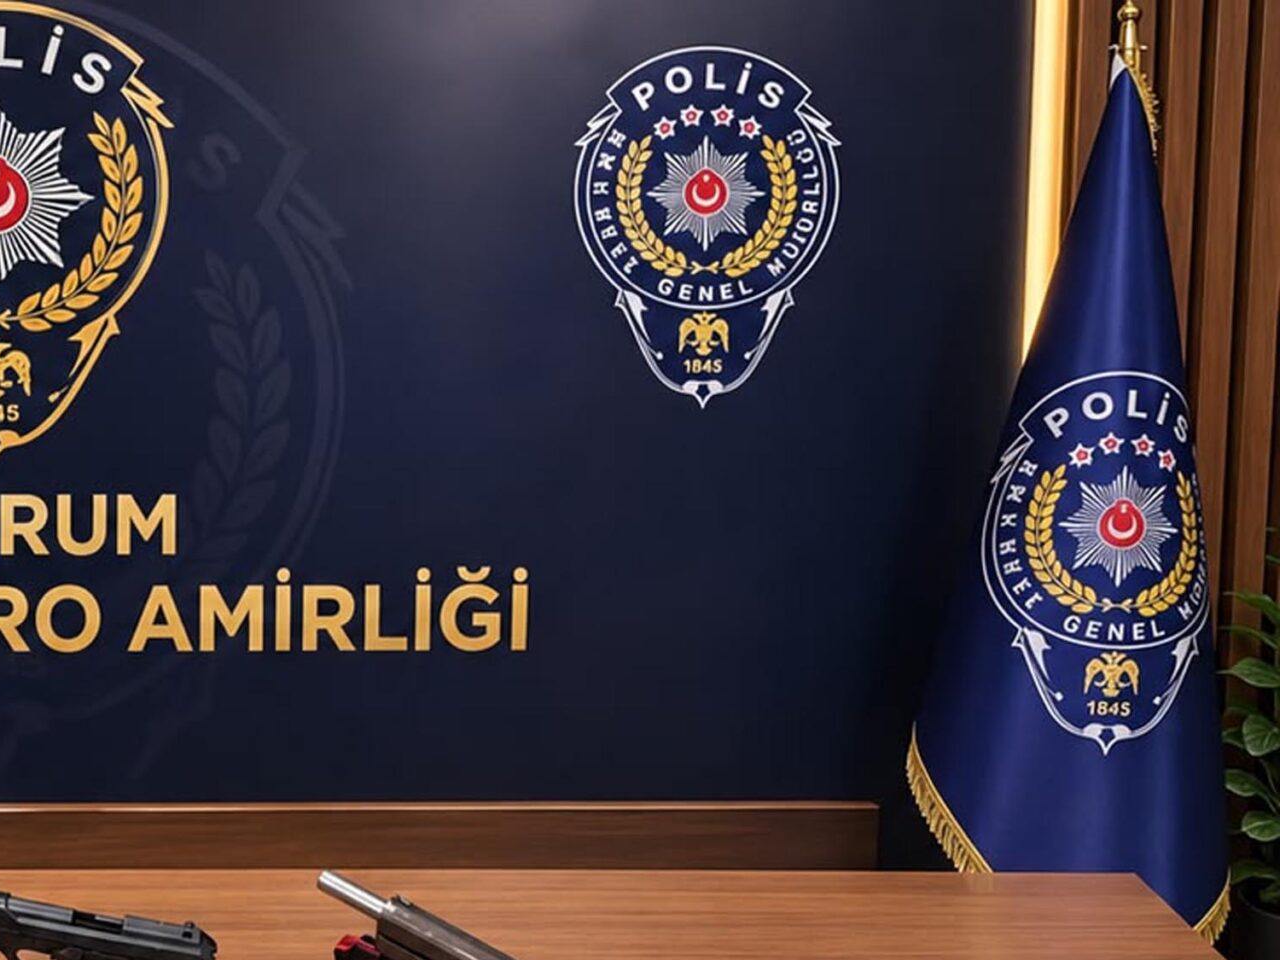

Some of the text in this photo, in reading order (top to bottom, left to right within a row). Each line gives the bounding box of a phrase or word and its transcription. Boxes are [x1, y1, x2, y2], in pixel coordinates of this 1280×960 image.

[631, 61, 786, 112] POLİS
[657, 277, 754, 302] GENEL
[1043, 388, 1189, 444] POLİS
[127, 565, 529, 653] AMİRLİĞİ
[1062, 614, 1167, 642] GENEL
[1086, 700, 1131, 717] 1845
